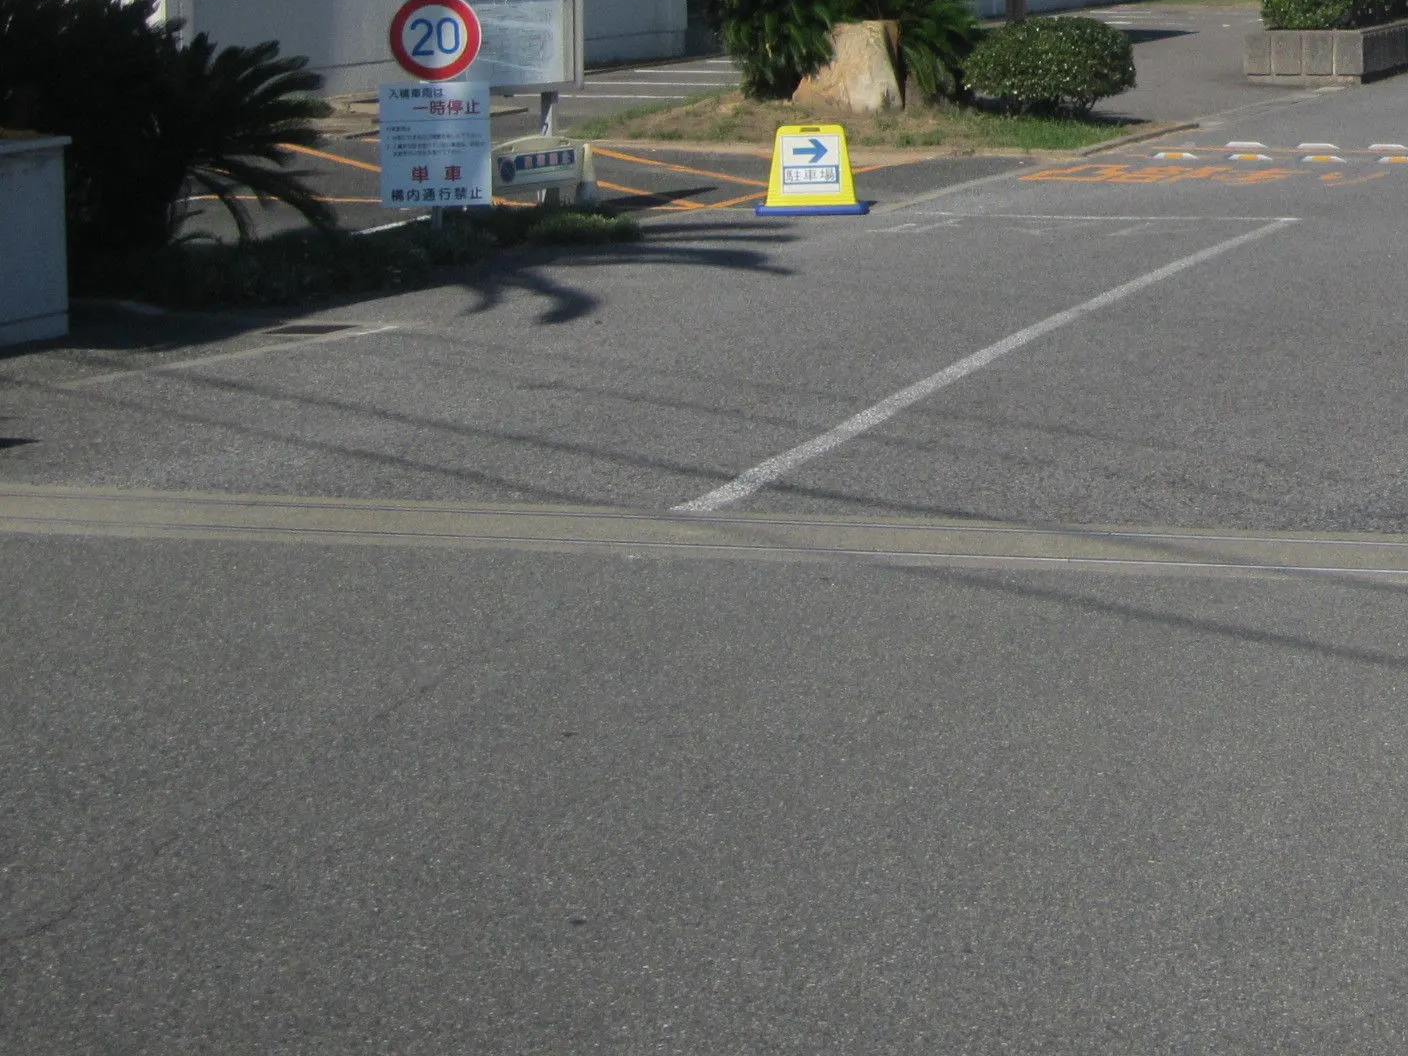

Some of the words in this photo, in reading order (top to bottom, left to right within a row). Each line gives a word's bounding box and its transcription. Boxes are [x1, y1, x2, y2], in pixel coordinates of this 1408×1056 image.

[410, 17, 461, 57] 20
[412, 99, 481, 116] 一時停止
[786, 168, 835, 182] 駐車場
[391, 186, 483, 202] 構内通行禁止
